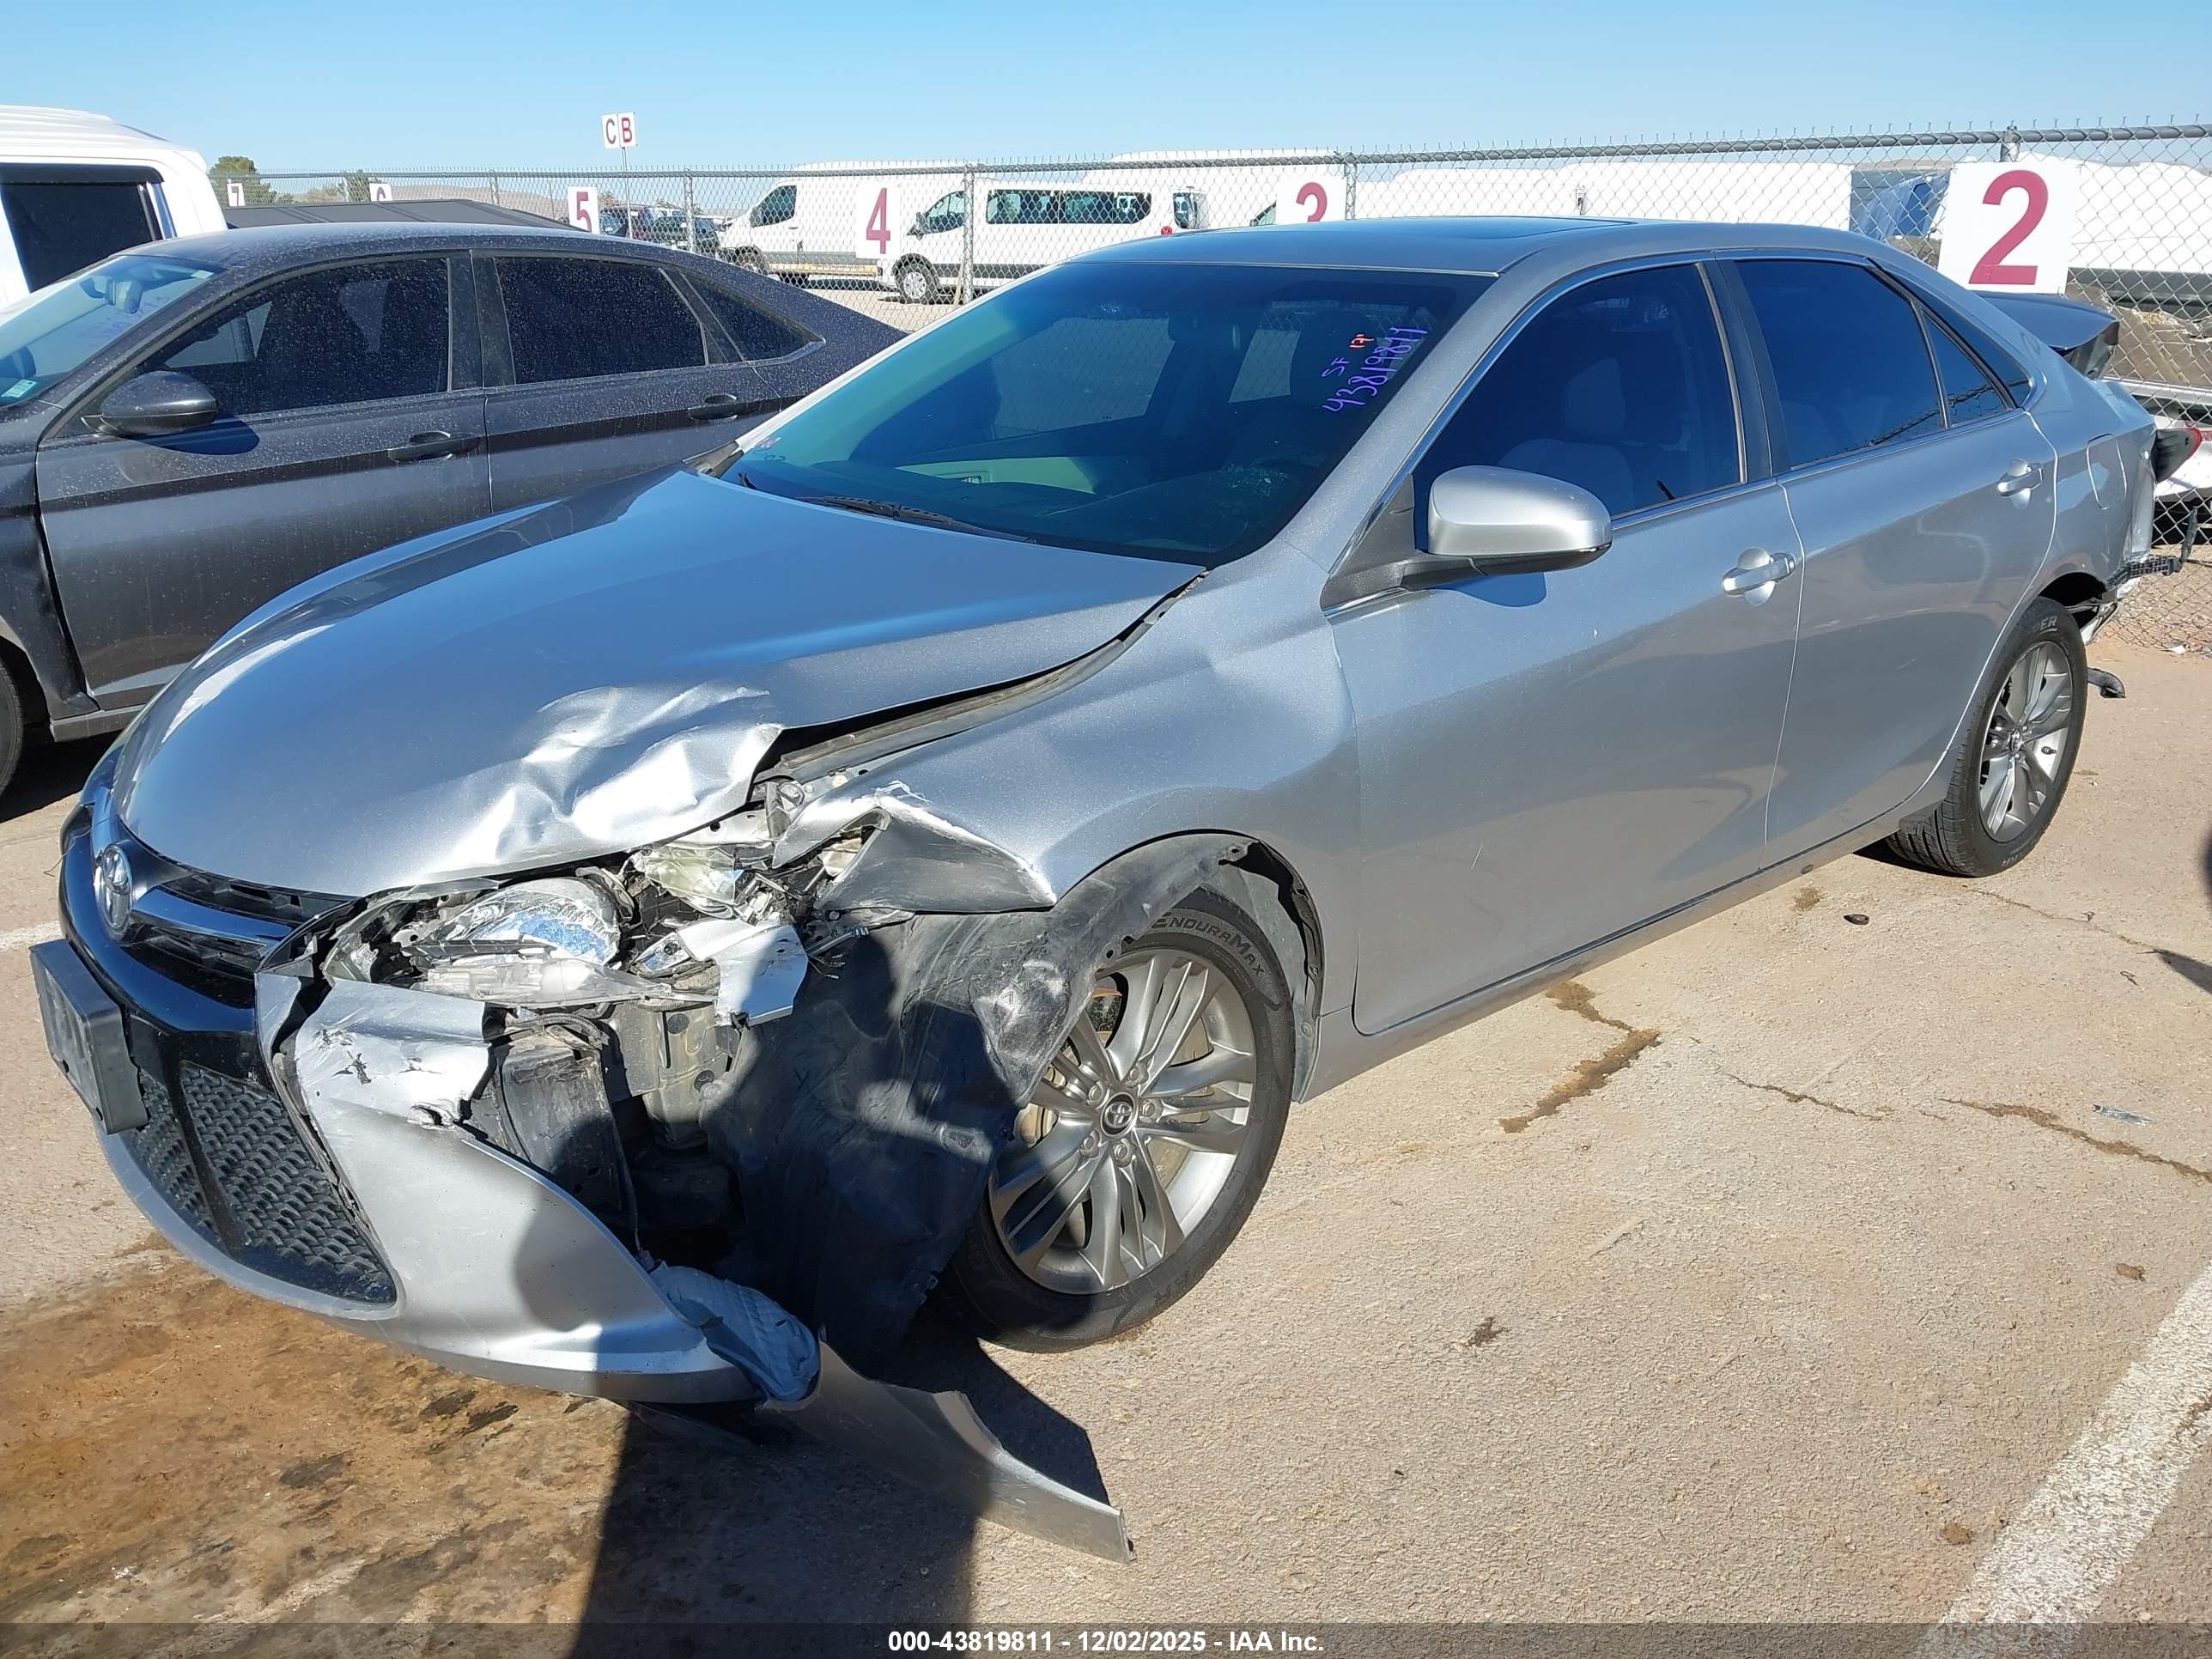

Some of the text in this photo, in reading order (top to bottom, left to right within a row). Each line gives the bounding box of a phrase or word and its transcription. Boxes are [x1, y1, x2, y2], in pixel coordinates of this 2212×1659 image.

[576, 191, 592, 233] 5
[866, 188, 890, 254] 4
[1968, 169, 2049, 285] 2
